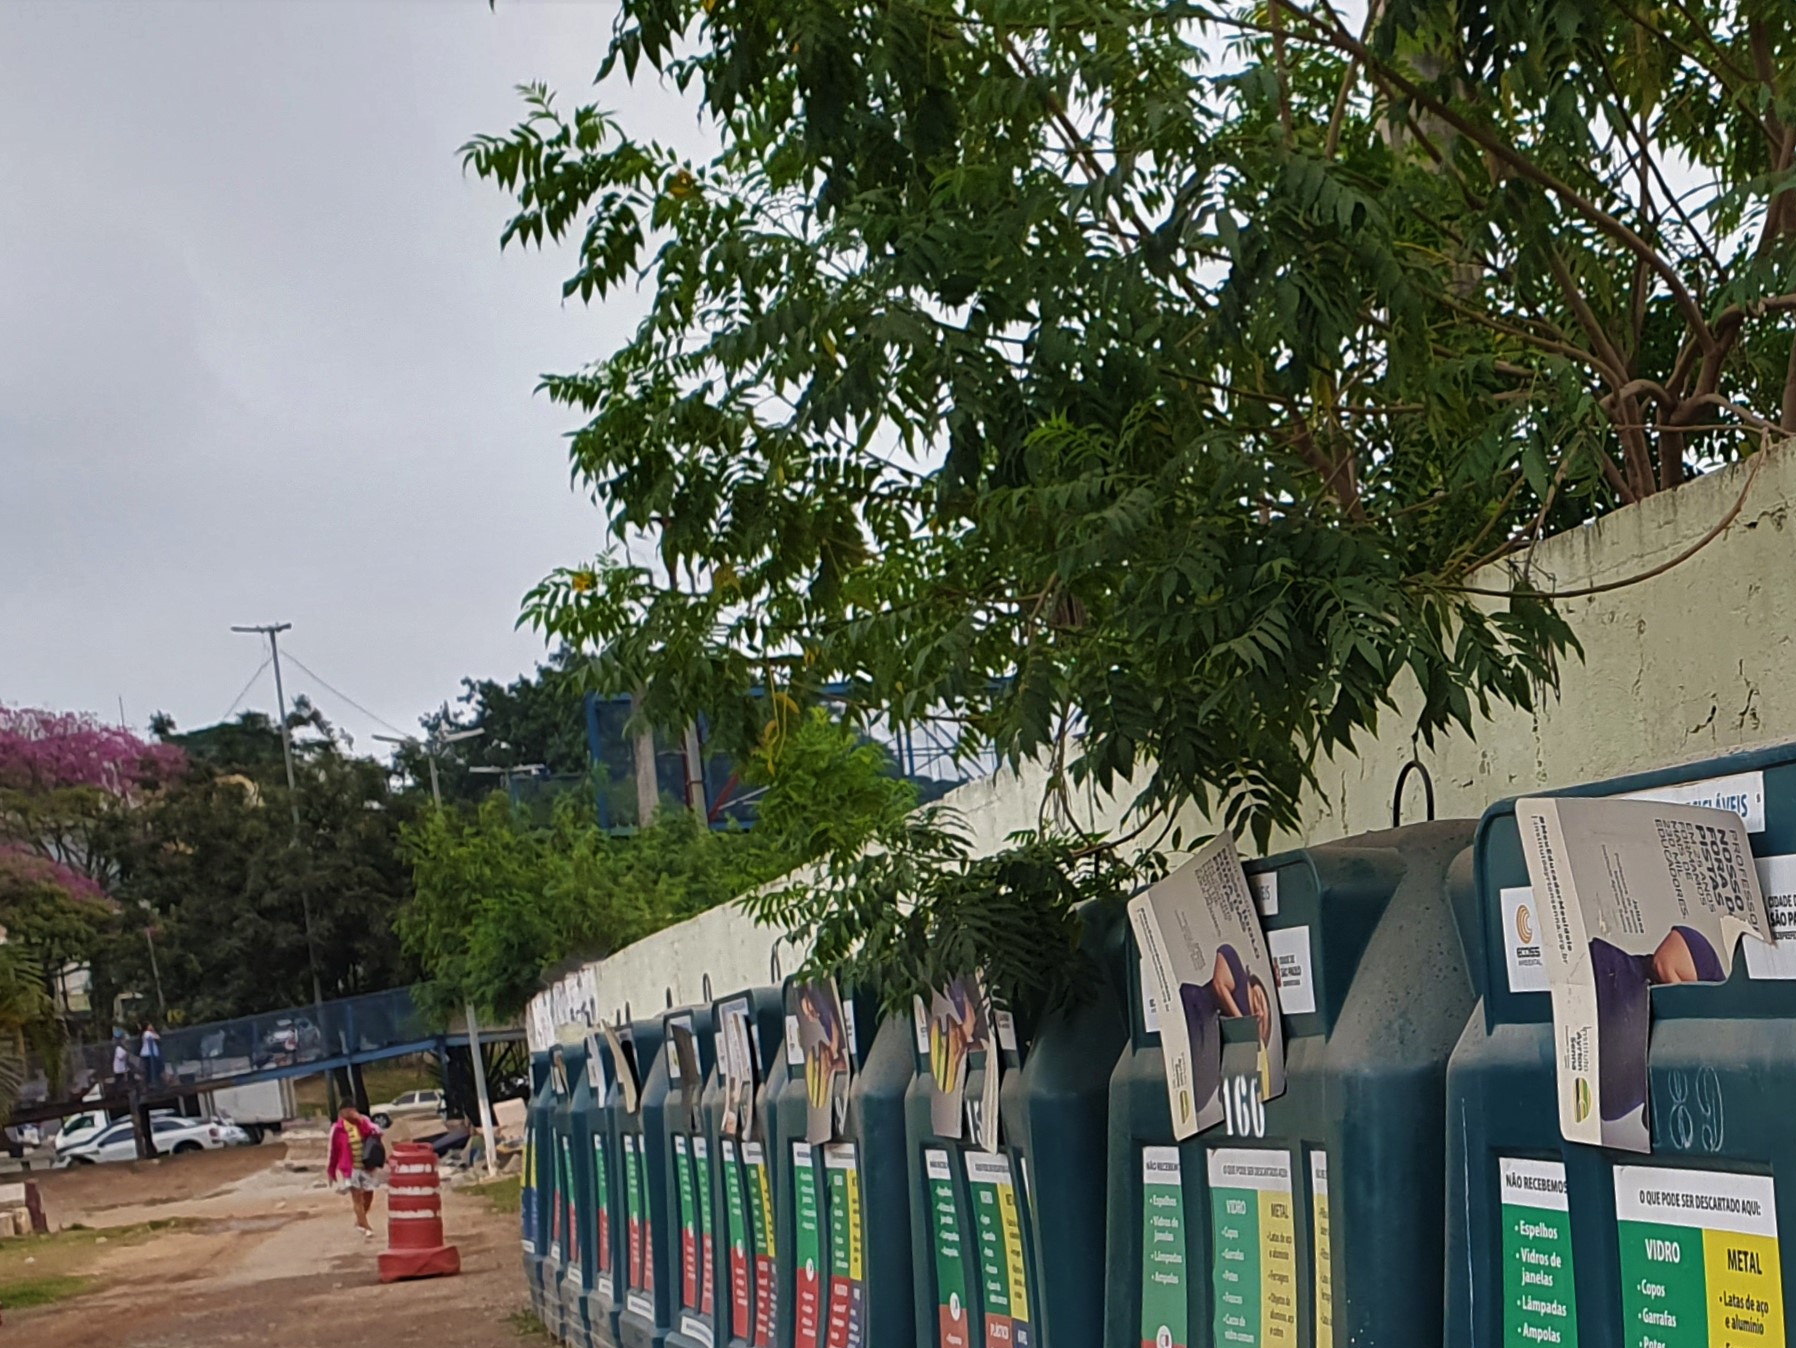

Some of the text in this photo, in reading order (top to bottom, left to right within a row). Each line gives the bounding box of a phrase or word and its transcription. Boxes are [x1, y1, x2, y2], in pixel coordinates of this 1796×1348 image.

[1678, 822, 1706, 906] FORMAMOS
[1695, 825, 1725, 906] PISTAS
[1706, 827, 1729, 888] FORA
[1717, 829, 1744, 911] NOSSO
[1770, 909, 1786, 927] SÃO
[1649, 1065, 1723, 1152] 89
[1506, 1172, 1568, 1195] NÃO RECEBEMOS
[1520, 1221, 1558, 1241] Espelhos
[1521, 1248, 1562, 1269] Vidros de
[1645, 1238, 1680, 1263] VIDRO
[1727, 1248, 1762, 1275] METAL
[1522, 1267, 1553, 1286] janelas
[1522, 1295, 1567, 1318] Lâmpadas
[1523, 1323, 1561, 1343] Ampolas
